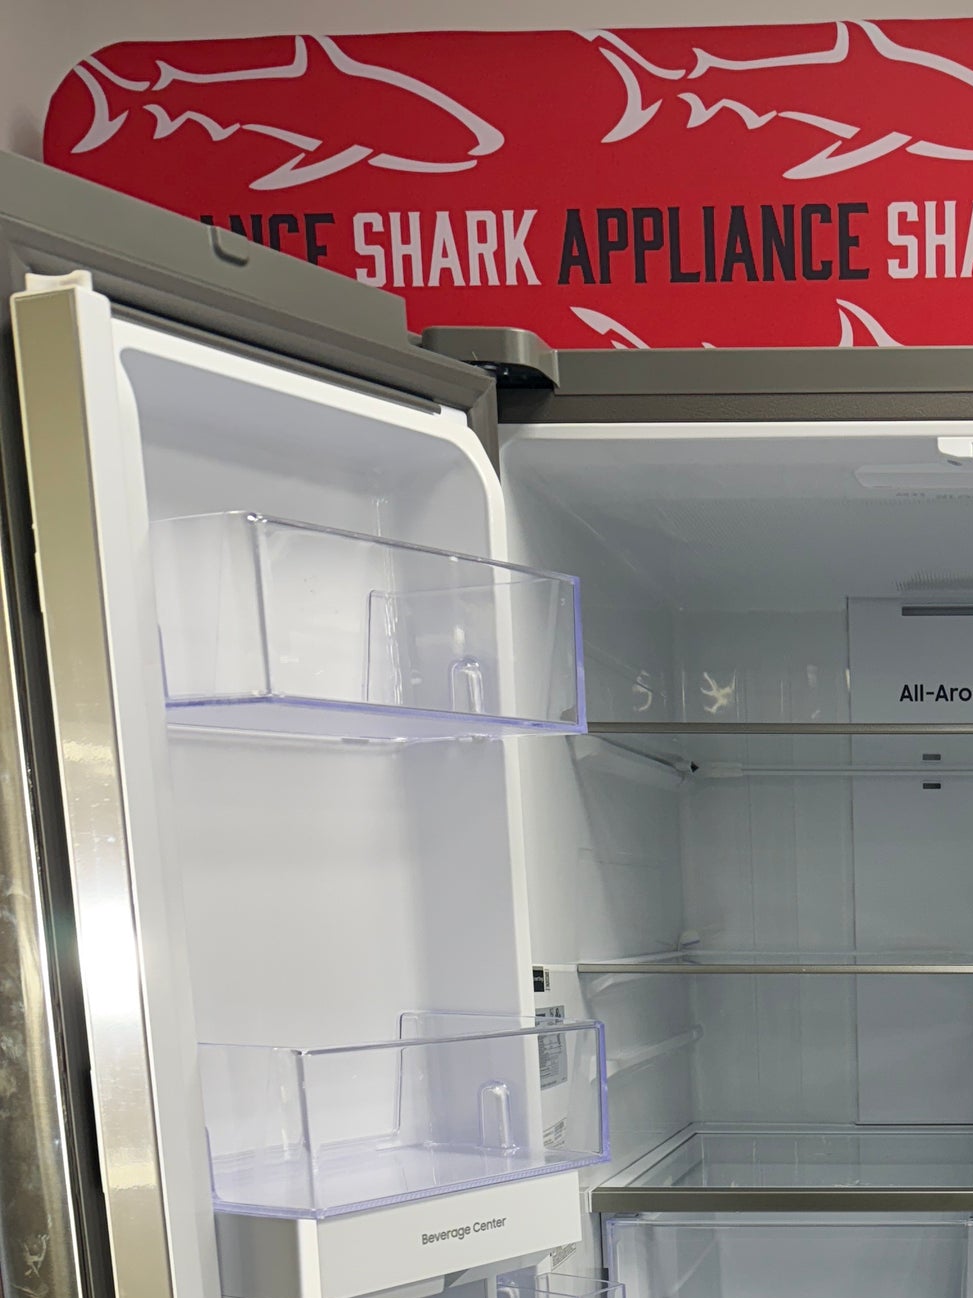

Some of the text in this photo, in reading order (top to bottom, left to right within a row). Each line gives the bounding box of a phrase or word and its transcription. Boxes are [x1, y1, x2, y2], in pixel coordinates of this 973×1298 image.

[352, 209, 541, 288] SHARK
[558, 202, 869, 285] APPLIANCE
[421, 1217, 507, 1245] Beverage Center
